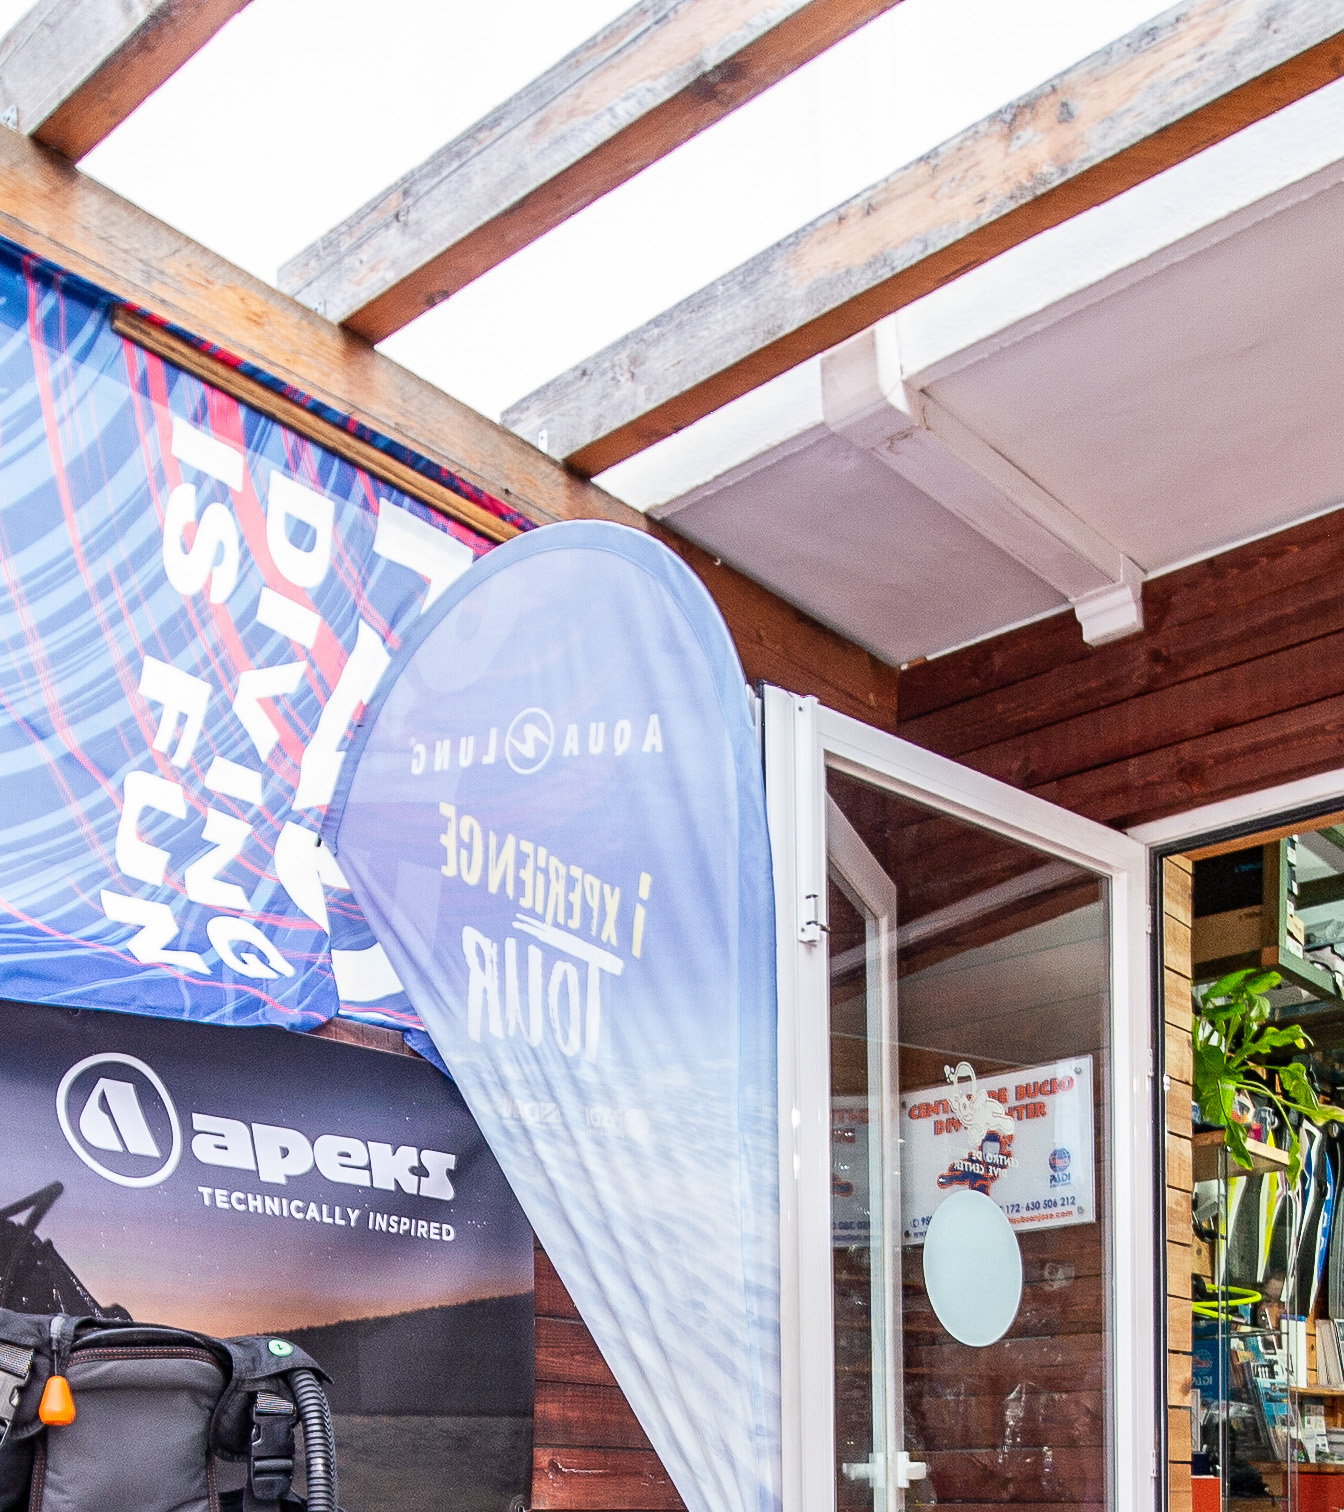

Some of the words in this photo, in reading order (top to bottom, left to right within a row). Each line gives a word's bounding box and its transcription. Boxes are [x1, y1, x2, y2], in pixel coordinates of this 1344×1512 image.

[161, 415, 245, 605] IS
[184, 469, 336, 980] DIVING
[99, 654, 213, 976] FUN
[1014, 1075, 1074, 1100] BUCEO
[190, 1112, 456, 1202] apeks
[197, 1185, 360, 1228] TECHNICALLY
[367, 1210, 456, 1243] INSPIRED
[1025, 1200, 1040, 1212] 630
[1043, 1198, 1058, 1210] 506
[1059, 1196, 1076, 1208] 212
